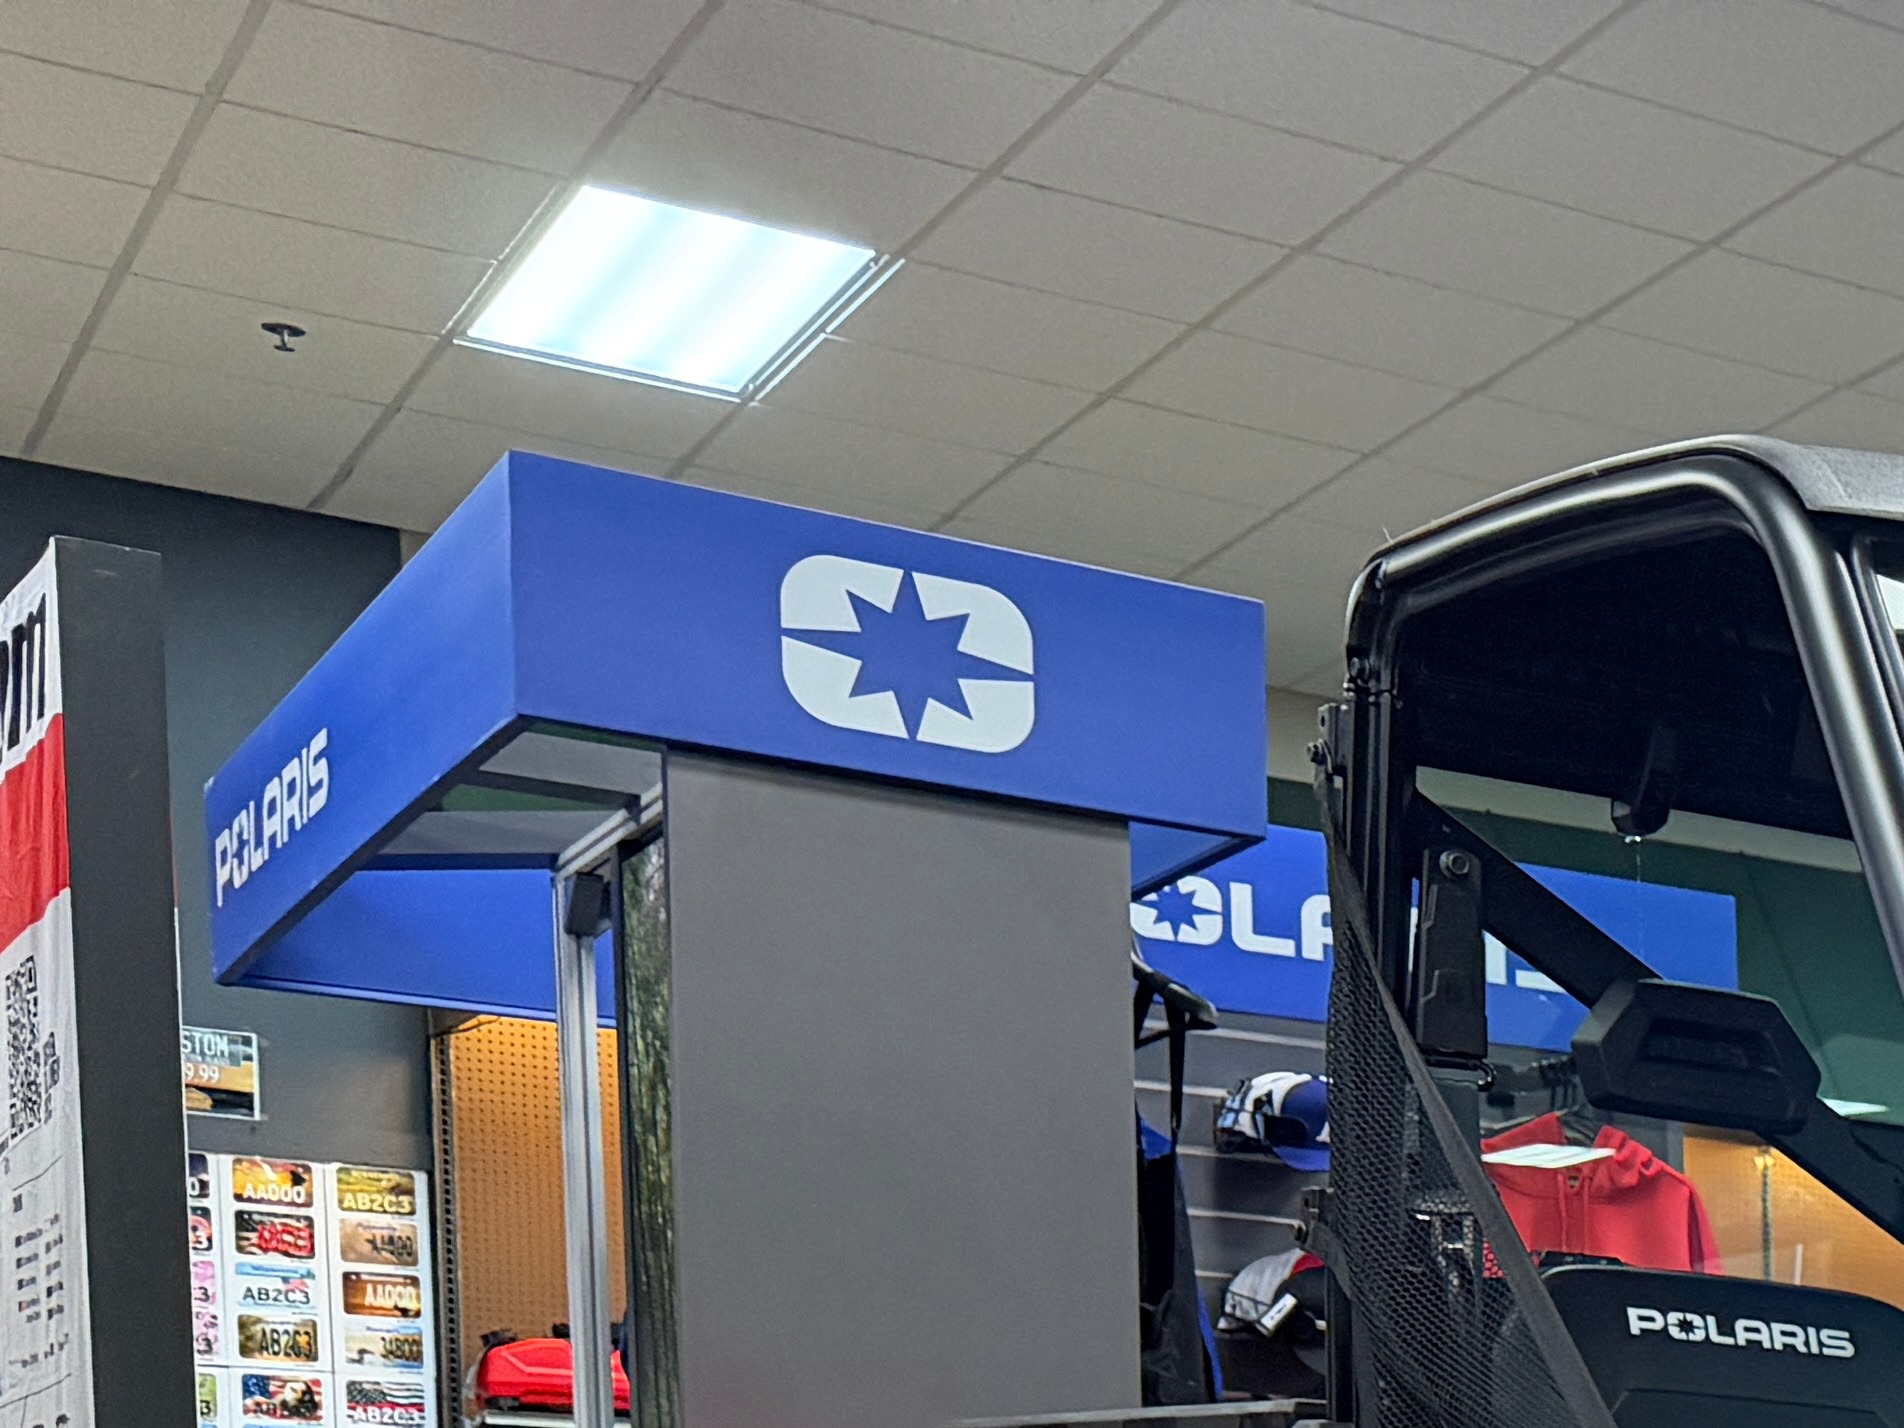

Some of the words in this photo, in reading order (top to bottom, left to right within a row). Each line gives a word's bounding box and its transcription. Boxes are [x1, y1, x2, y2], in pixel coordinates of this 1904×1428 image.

[215, 727, 329, 908] POLARIS
[181, 1031, 229, 1057] STOM
[342, 1191, 413, 1214] AB2C3
[242, 1285, 311, 1305] AB2C3
[1626, 1305, 1855, 1359] POLARIS
[353, 1405, 421, 1425] AB2C3
